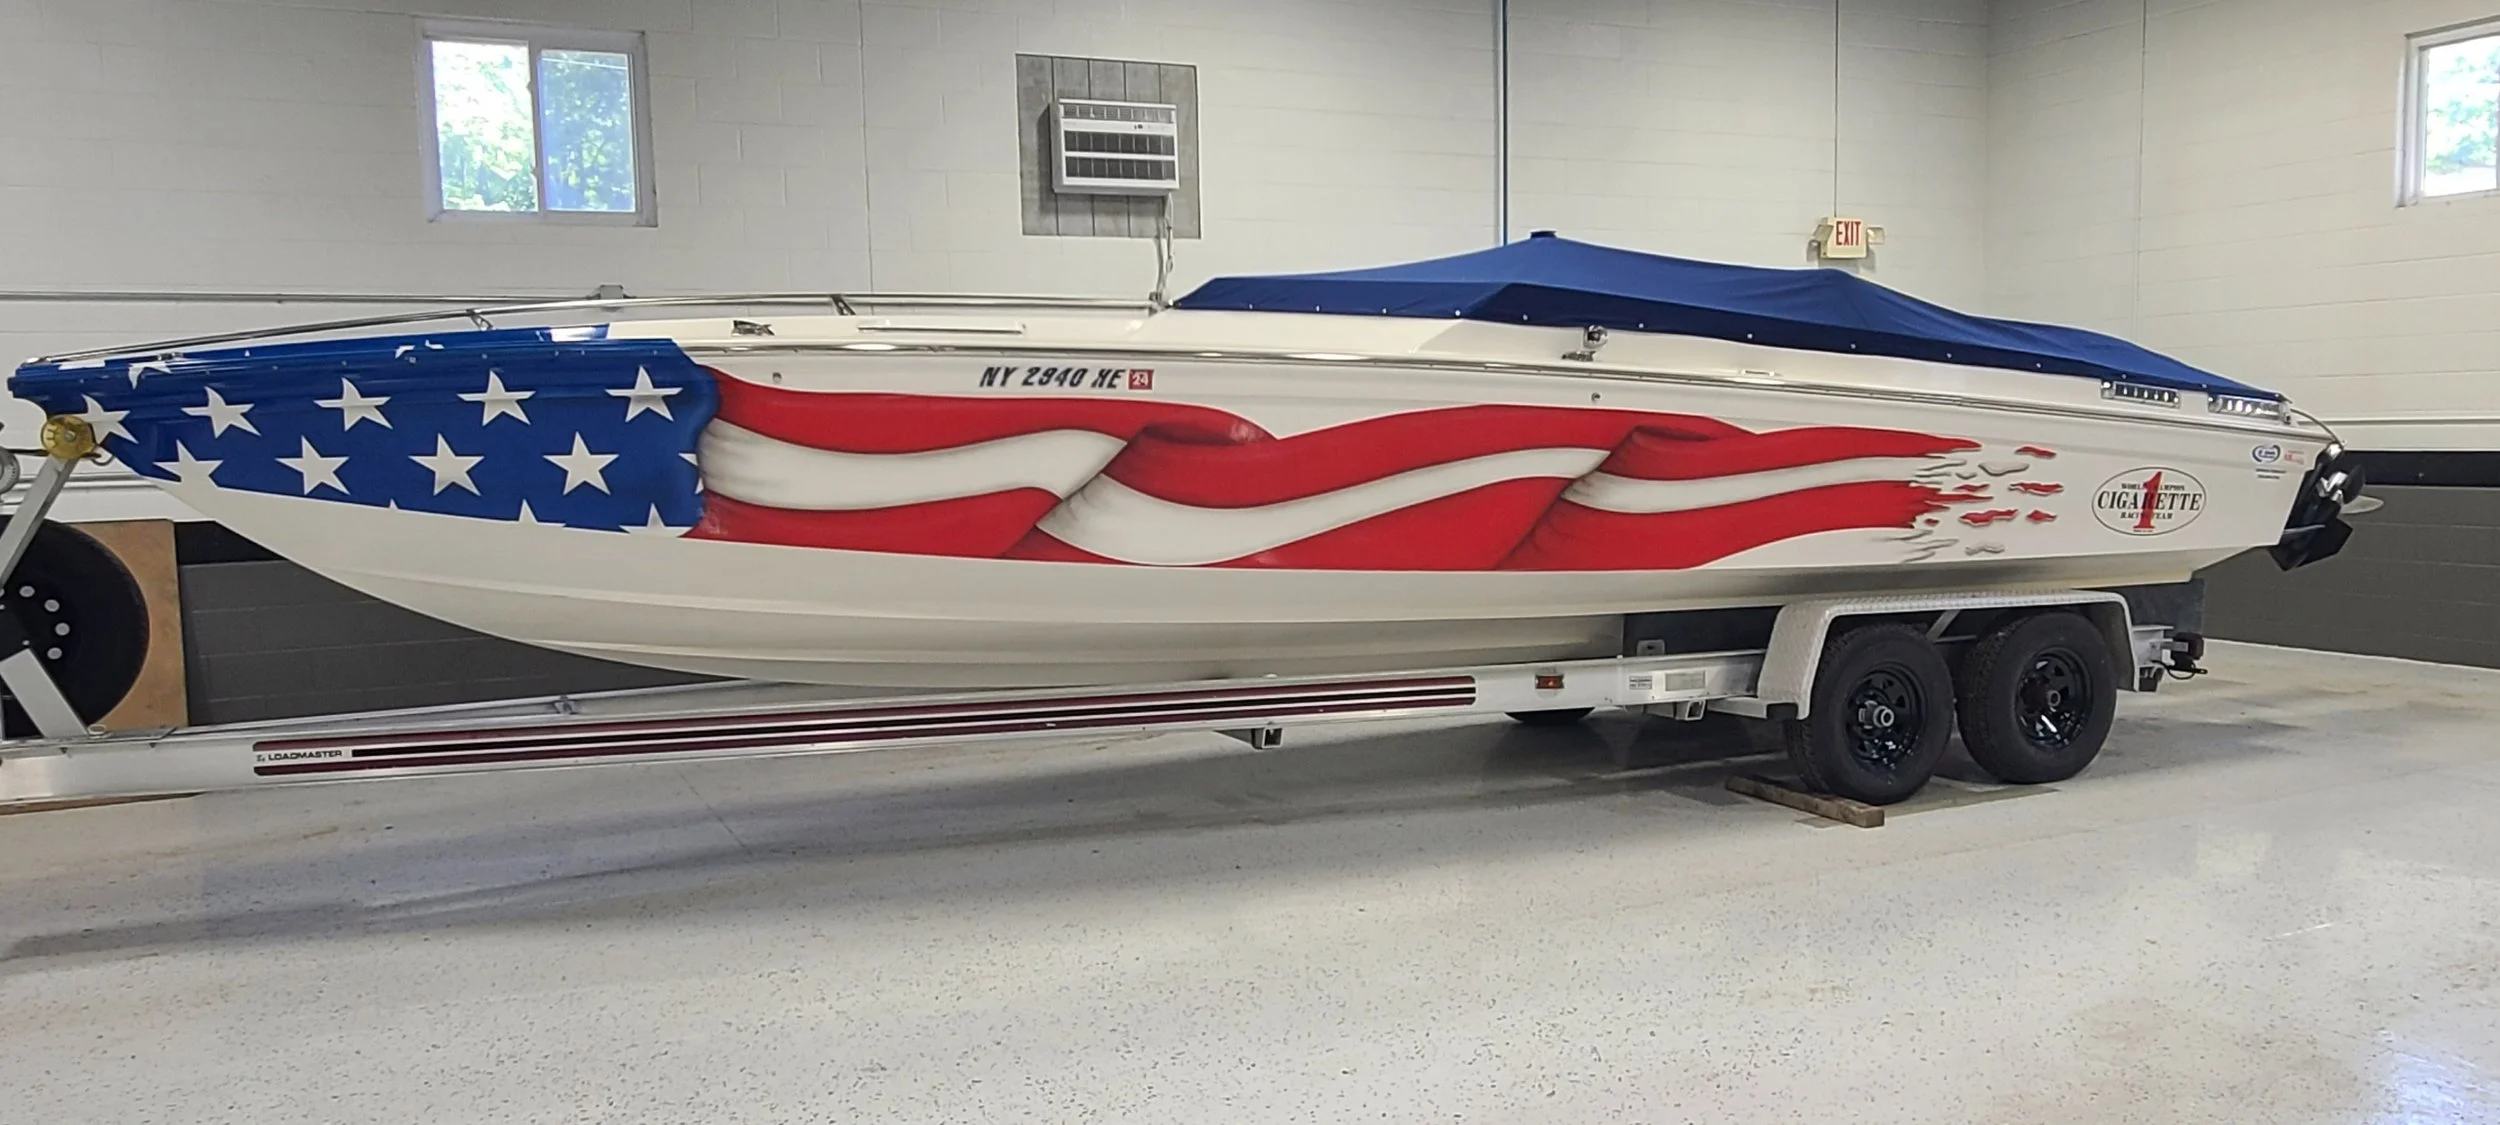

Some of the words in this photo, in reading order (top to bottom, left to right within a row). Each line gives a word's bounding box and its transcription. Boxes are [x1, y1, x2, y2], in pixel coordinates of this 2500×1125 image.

[1836, 221, 1861, 246] EXIT
[980, 367, 1018, 387] NY
[1132, 372, 1149, 386] 24
[2098, 491, 2202, 511] CIGARETTE
[268, 750, 342, 761] LOADMASTER
